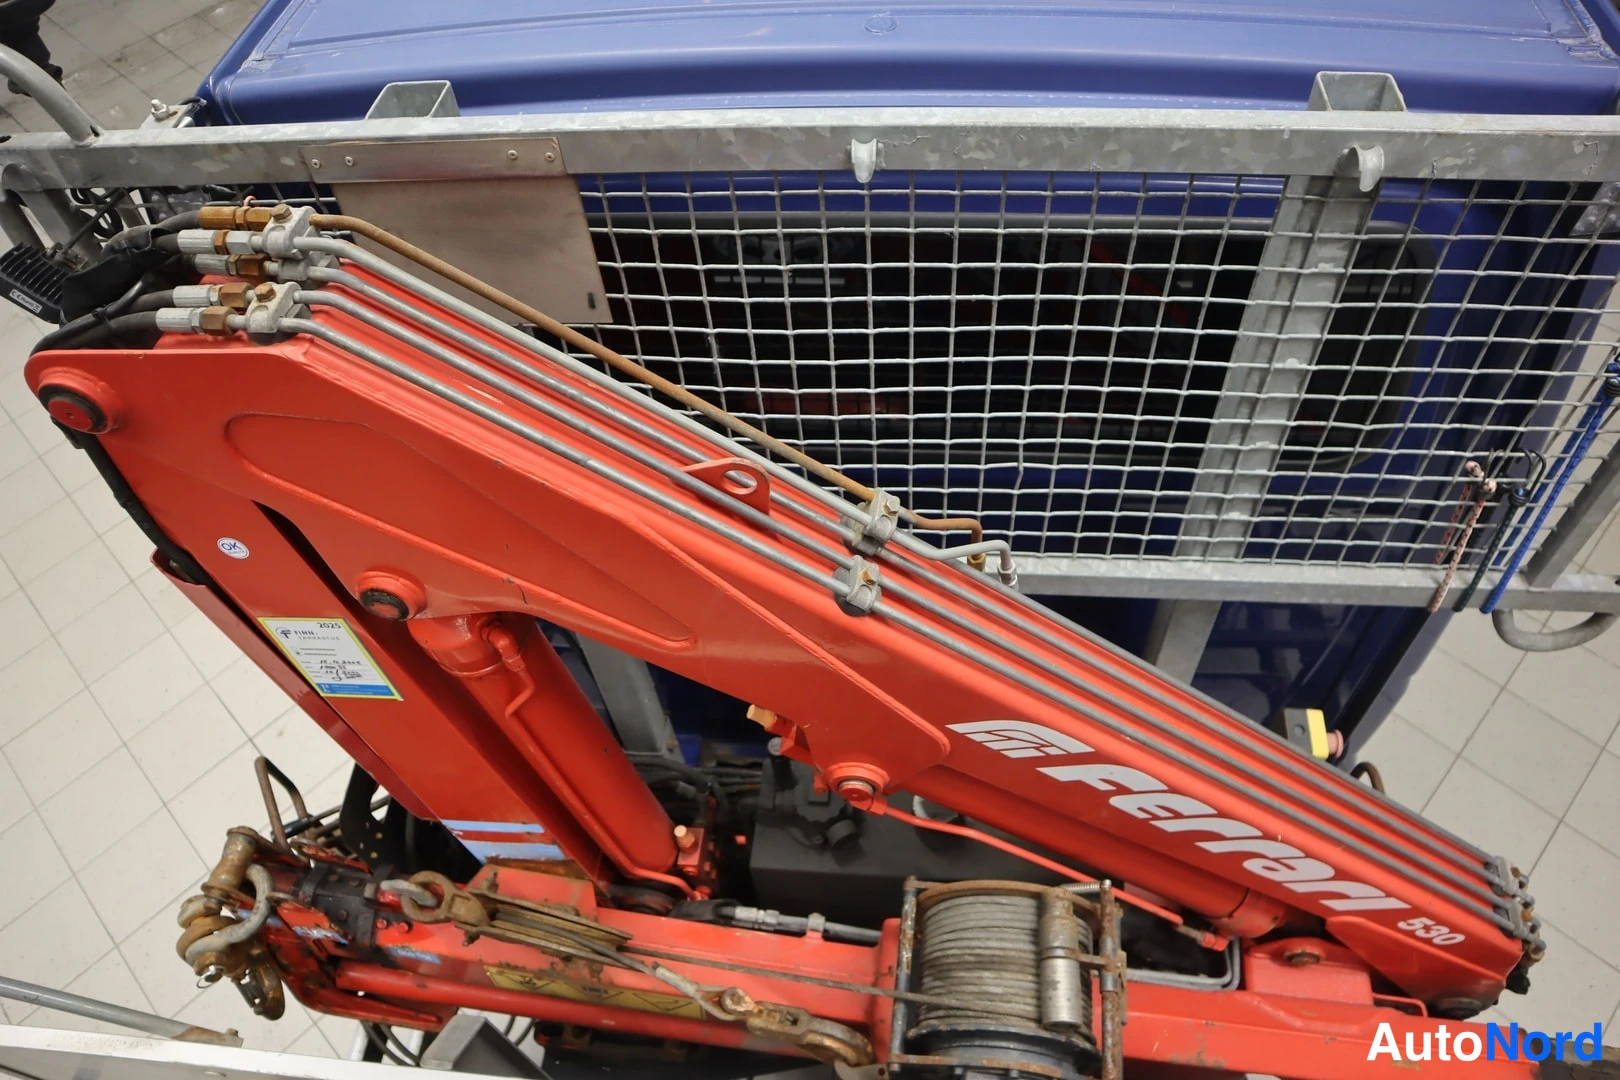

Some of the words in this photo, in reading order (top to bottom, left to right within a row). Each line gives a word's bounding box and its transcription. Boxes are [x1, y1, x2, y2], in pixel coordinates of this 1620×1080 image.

[221, 542, 242, 551] OK
[1036, 764, 1411, 910] Ferrari
[1397, 916, 1466, 945] 530
